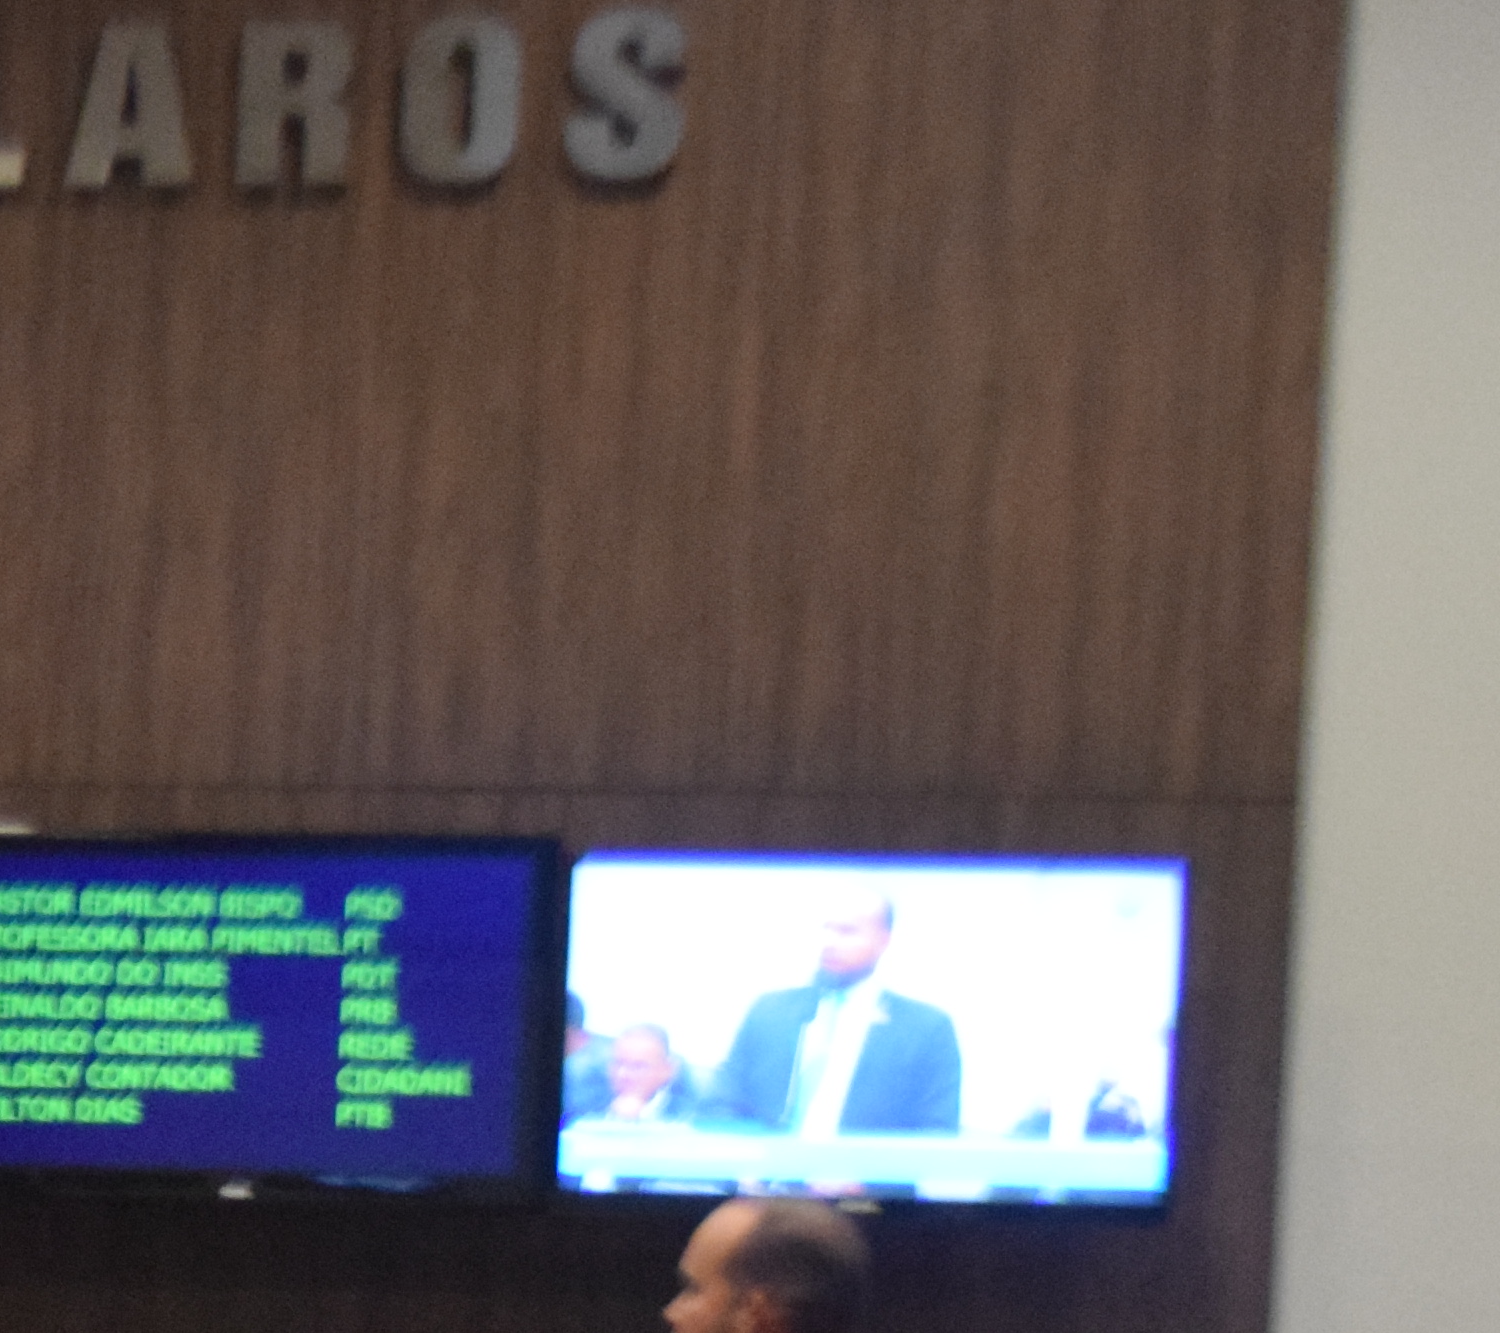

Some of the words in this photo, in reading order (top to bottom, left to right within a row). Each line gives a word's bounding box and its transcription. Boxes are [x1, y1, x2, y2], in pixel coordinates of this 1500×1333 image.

[79, 886, 215, 918] EDMILSON
[115, 958, 161, 987] DO
[104, 992, 229, 1023] BARBOSA
[95, 1026, 262, 1059] CADEIRANTE
[338, 1030, 414, 1060] REDE
[85, 1060, 234, 1092] CONTADOR
[74, 1096, 143, 1124] DIAS
